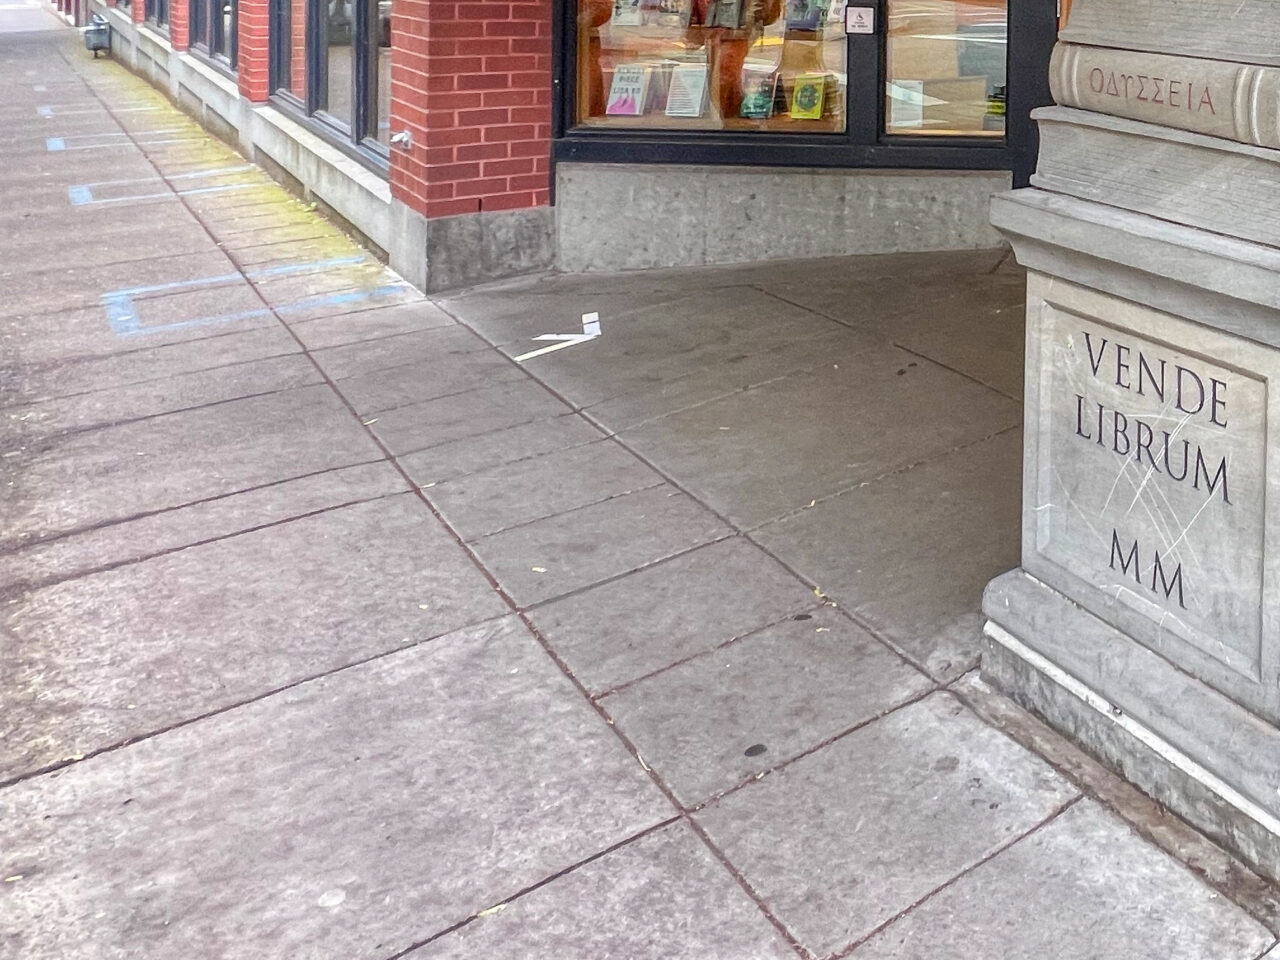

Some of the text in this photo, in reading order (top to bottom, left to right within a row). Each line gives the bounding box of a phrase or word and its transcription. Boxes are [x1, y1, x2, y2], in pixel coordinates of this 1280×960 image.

[1089, 67, 1216, 115] ΟΔΥΣΣΕΙΑ
[1082, 331, 1228, 428] VENDE
[1075, 394, 1233, 506] LIBRUM
[1109, 528, 1188, 611] MM
